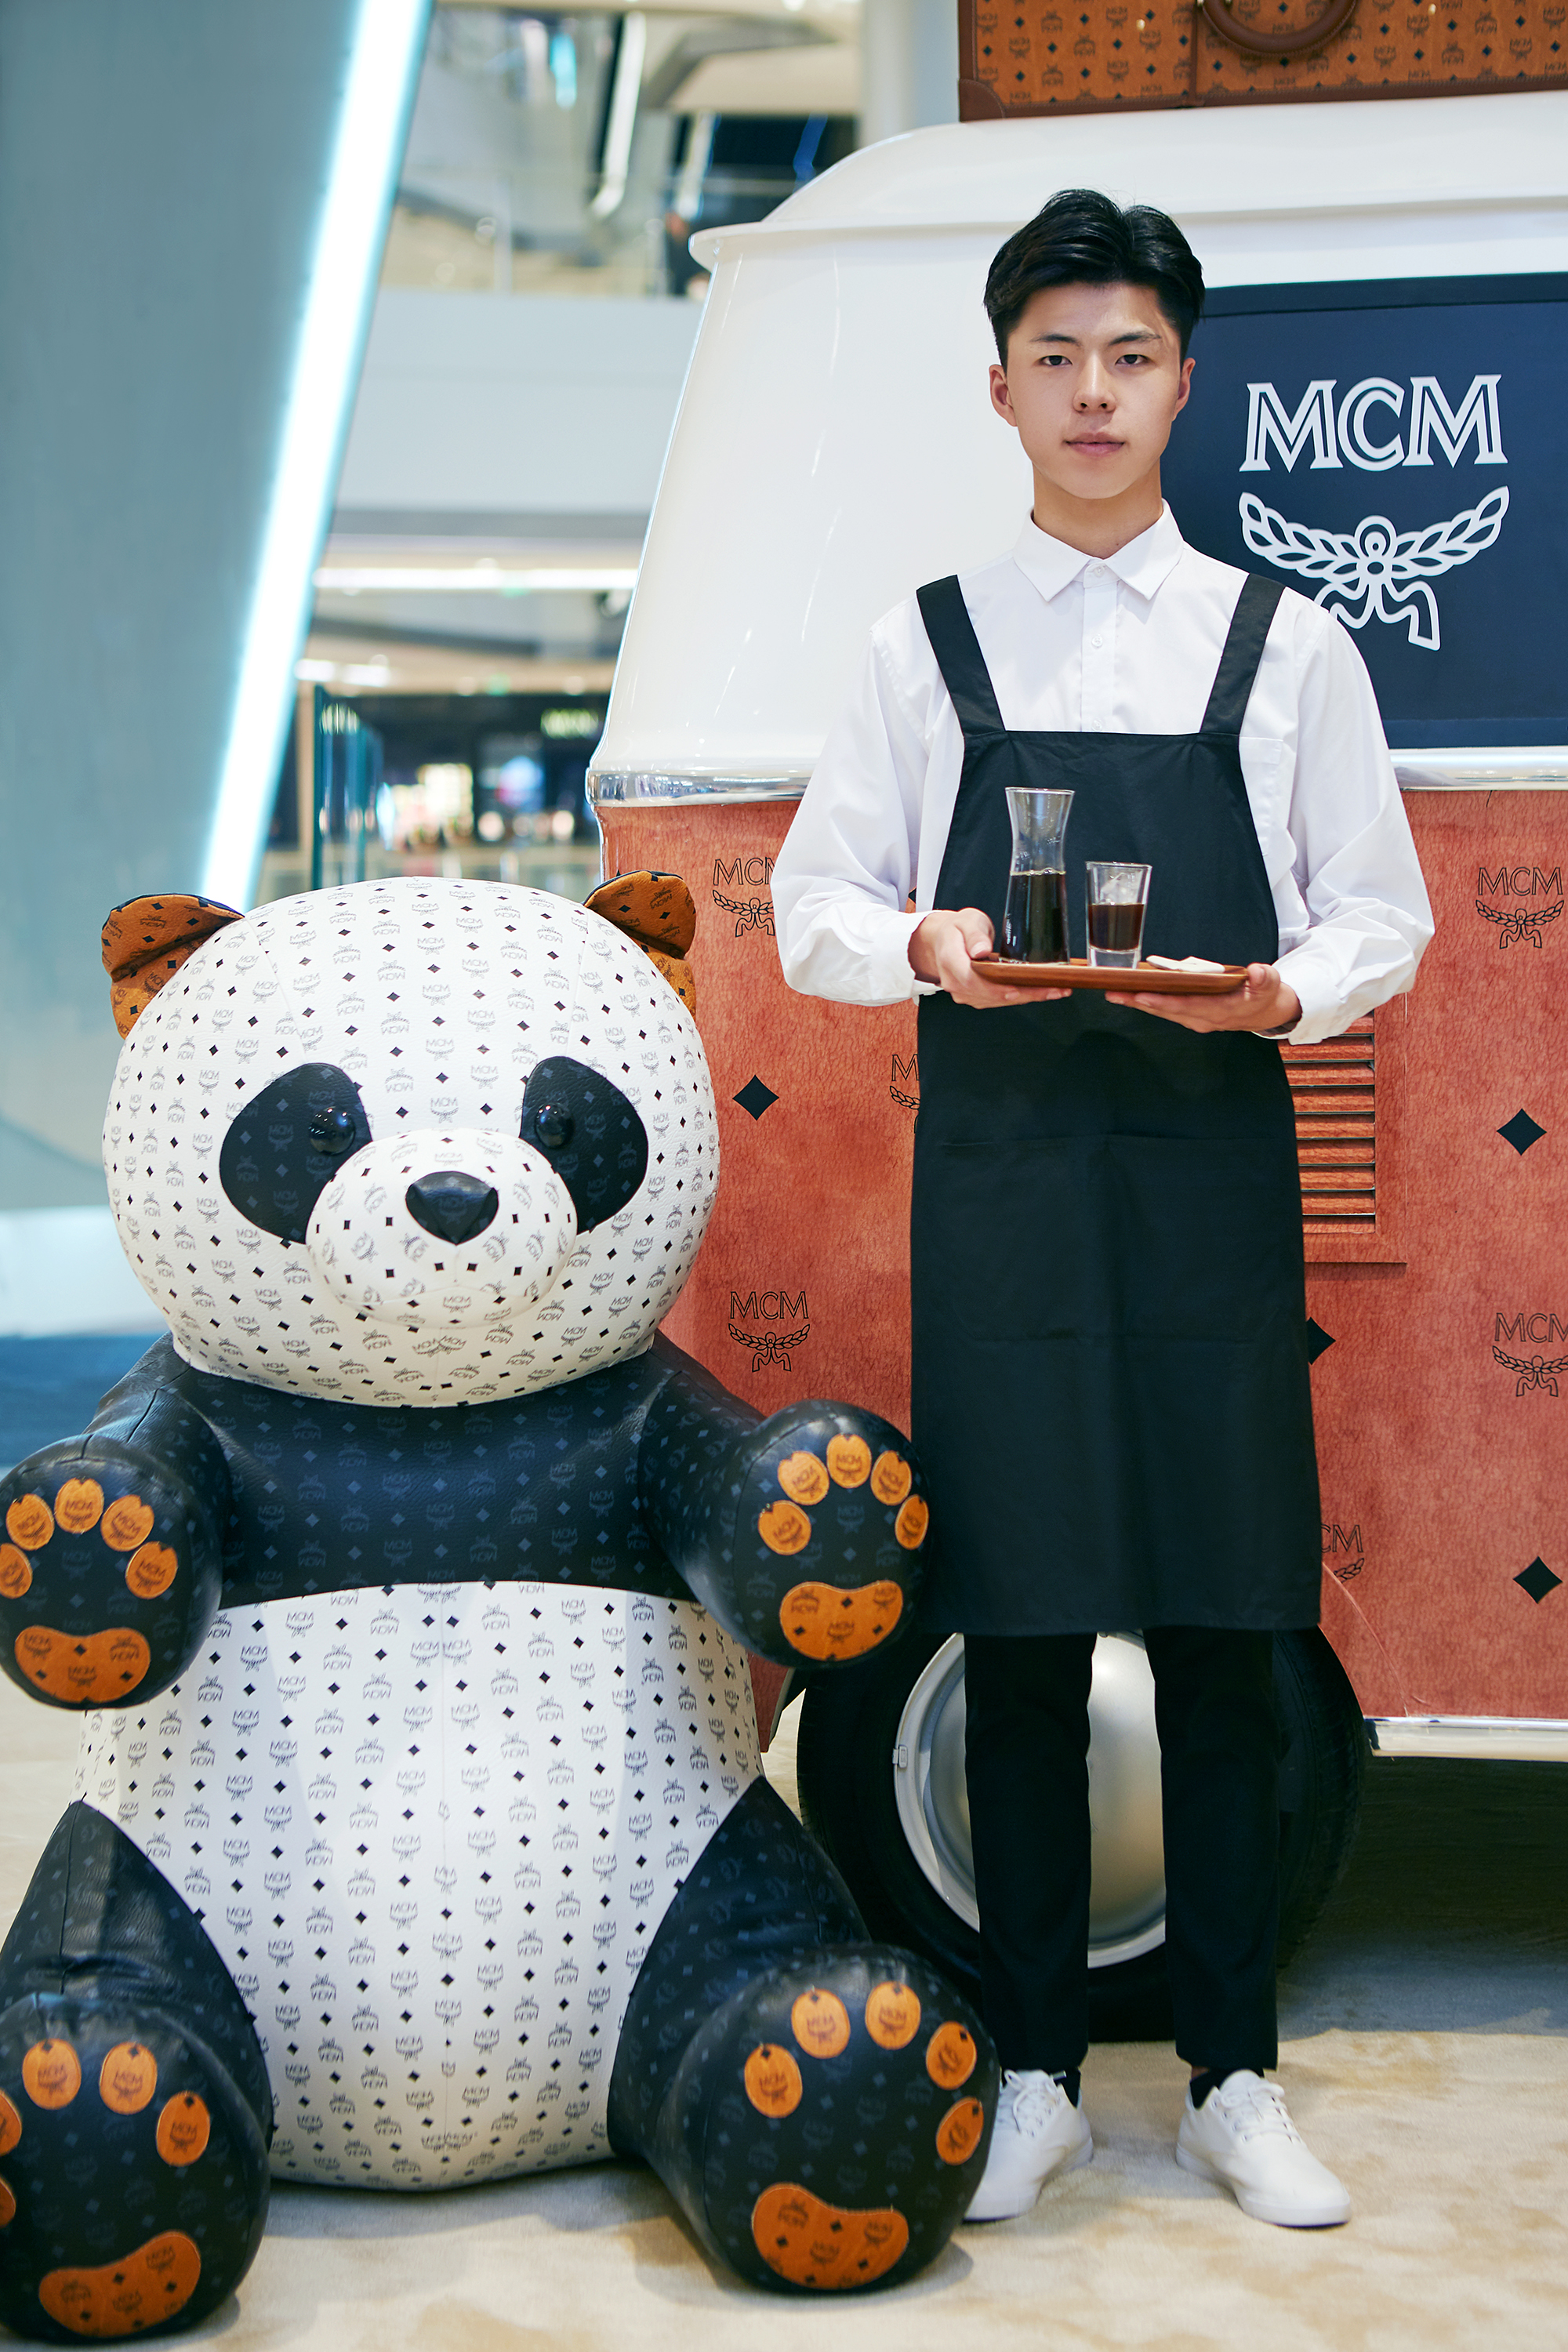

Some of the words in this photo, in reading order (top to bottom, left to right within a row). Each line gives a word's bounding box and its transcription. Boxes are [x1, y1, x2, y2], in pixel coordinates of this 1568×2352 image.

[1239, 374, 1508, 473] MCM
[1478, 867, 1563, 896] MCM
[730, 1291, 809, 1319] MCM
